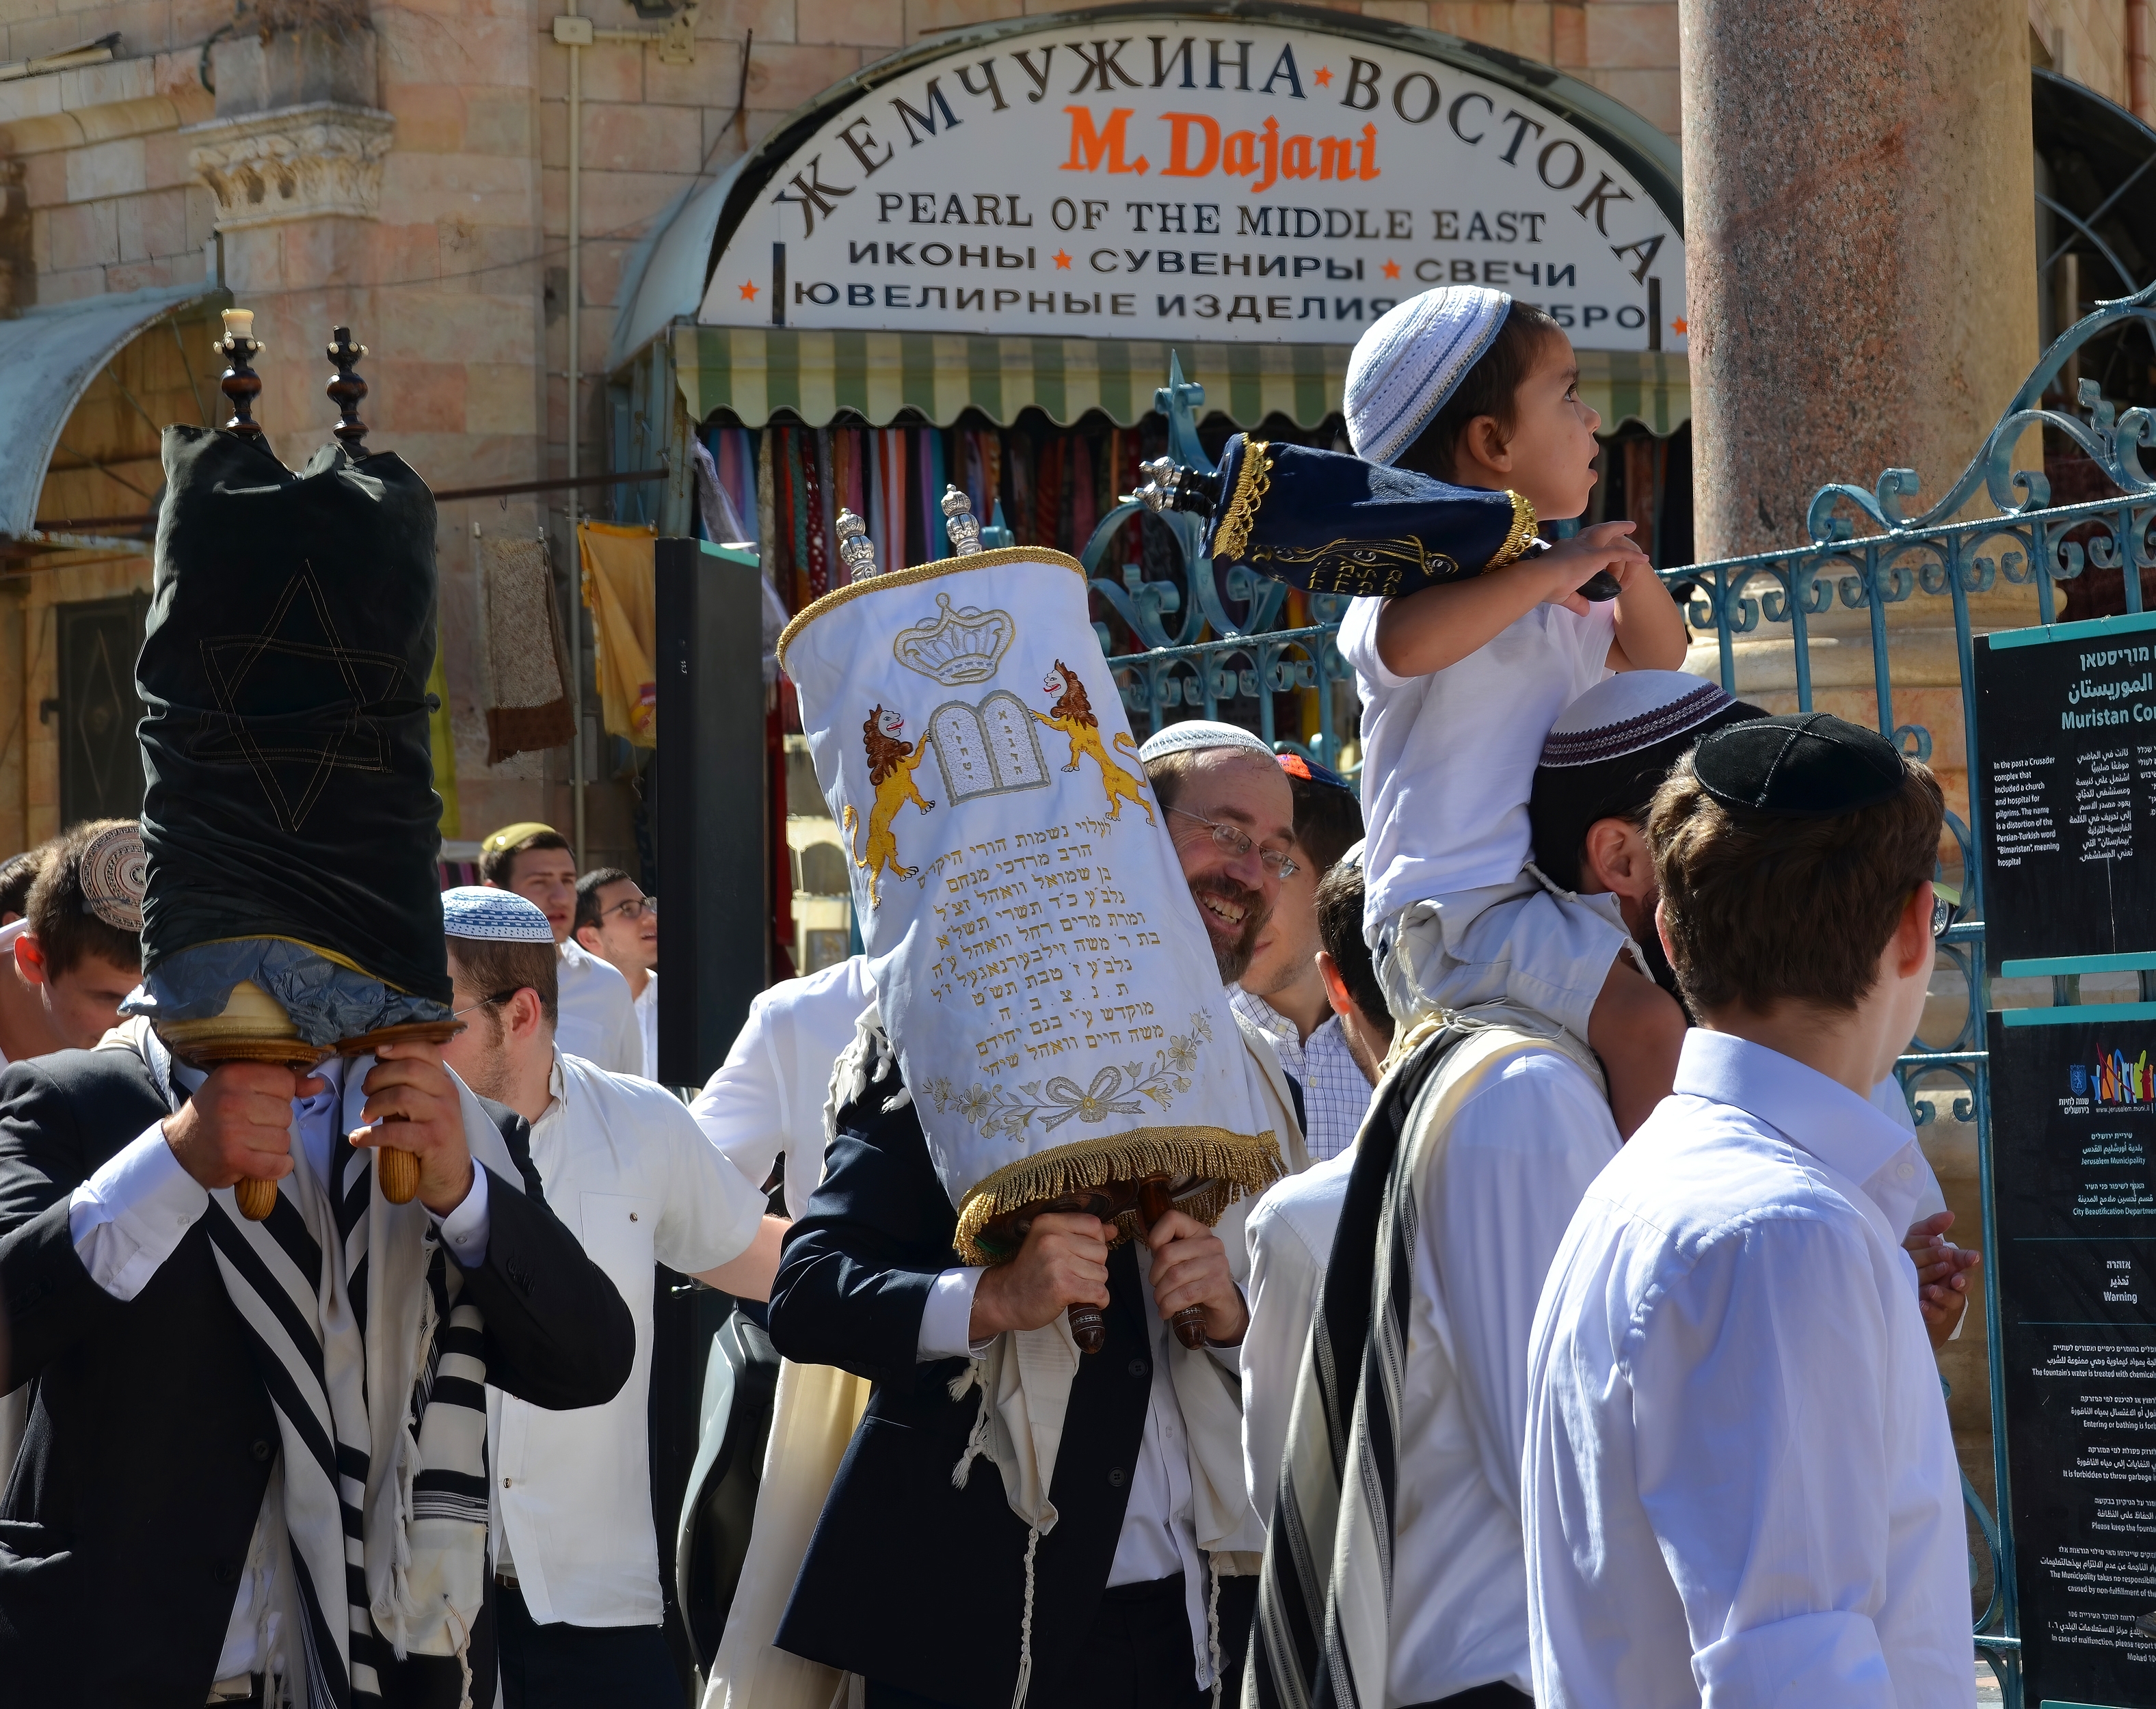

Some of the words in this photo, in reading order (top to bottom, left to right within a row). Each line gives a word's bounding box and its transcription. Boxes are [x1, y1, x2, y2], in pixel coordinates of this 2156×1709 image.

[1059, 105, 1150, 176] M.
[1158, 112, 1381, 193] Dajani
[772, 35, 1307, 240] ЖЕМЧУЖИНА
[1339, 55, 1667, 287] ВОСТОКА
[877, 192, 1033, 228] PEARL
[1050, 196, 1109, 232] OF
[1126, 202, 1221, 234] THE
[1236, 205, 1413, 240] MIDDLE
[1433, 209, 1547, 244] EAST
[849, 240, 1036, 270] ИКОНЫ
[1089, 247, 1364, 280] СУВЕНИРЫ
[1414, 258, 1577, 287] СВЕЧИ
[794, 281, 1136, 316] ЮВЕЛИРНЫЕ
[1157, 293, 1398, 323] ИЗДЕЛИЯ
[2079, 647, 2150, 671] מוריסטאן
[2068, 672, 2153, 704] الموريستان
[2062, 708, 2129, 730] Muristan
[2000, 760, 2010, 769] the
[2011, 759, 2024, 769] past
[2029, 755, 2055, 766] Crusader
[1994, 772, 2019, 782] complex
[2019, 770, 2032, 779] that
[1995, 783, 2020, 794] included
[2025, 781, 2045, 791] church
[1995, 796, 2006, 806] and
[2007, 794, 2031, 806] hospital
[2031, 794, 2040, 803] for
[1995, 809, 2021, 820] pilgrims.
[2021, 807, 2032, 816] The
[1996, 822, 2001, 831] is
[2006, 819, 2035, 829] distortion
[2036, 818, 2042, 827] of
[2042, 818, 2053, 826] the
[2040, 829, 2056, 838] word
[1015, 825, 1069, 848] נשמות
[969, 838, 1007, 856] הורי
[1057, 844, 1092, 861] הרב
[2034, 842, 2060, 852] meaning
[996, 853, 1050, 874] מרדכי
[1997, 857, 2021, 867] hospital
[946, 869, 989, 893] מנחם
[1031, 867, 1090, 889] שמואל
[1096, 865, 1112, 885] בן
[974, 882, 1028, 905] וואהל
[996, 902, 1042, 921] תשרי
[1107, 912, 1146, 926] ומרת
[1016, 922, 1053, 942] רחל
[1059, 914, 1101, 932] מרים
[960, 934, 1012, 960] וואהל
[1073, 937, 1110, 952] משה
[1136, 932, 1160, 946] בת
[1025, 968, 1063, 989] טבת
[1100, 1001, 1154, 1024] מוקדש
[1029, 1015, 1063, 1035] בנם
[1128, 1025, 1164, 1043] משה
[976, 1027, 1022, 1057] יחידם
[1024, 1036, 1079, 1060] וואהל
[1084, 1031, 1121, 1049] חיים
[2110, 1156, 2146, 1166] Municipality
[2073, 1207, 2084, 1217] City
[2085, 1207, 2125, 1215] Beautification
[2106, 1261, 2131, 1269] אזהרה
[2110, 1275, 2129, 1288] تحذير
[2103, 1291, 2138, 1304] Warning
[2032, 1368, 2042, 1376] The
[2094, 1369, 2115, 1377] treated
[2116, 1369, 2129, 1377] with
[2083, 1419, 2107, 1429] Entering
[2116, 1421, 2138, 1431] bathing
[2073, 1469, 2102, 1479] forbidden
[2110, 1471, 2127, 1479] throw
[2128, 1473, 2152, 1483] garbage
[2092, 1522, 2110, 1531] Please
[2049, 1570, 2060, 1578] The
[2061, 1570, 2096, 1582] Municipality
[2088, 1585, 2096, 1595] by
